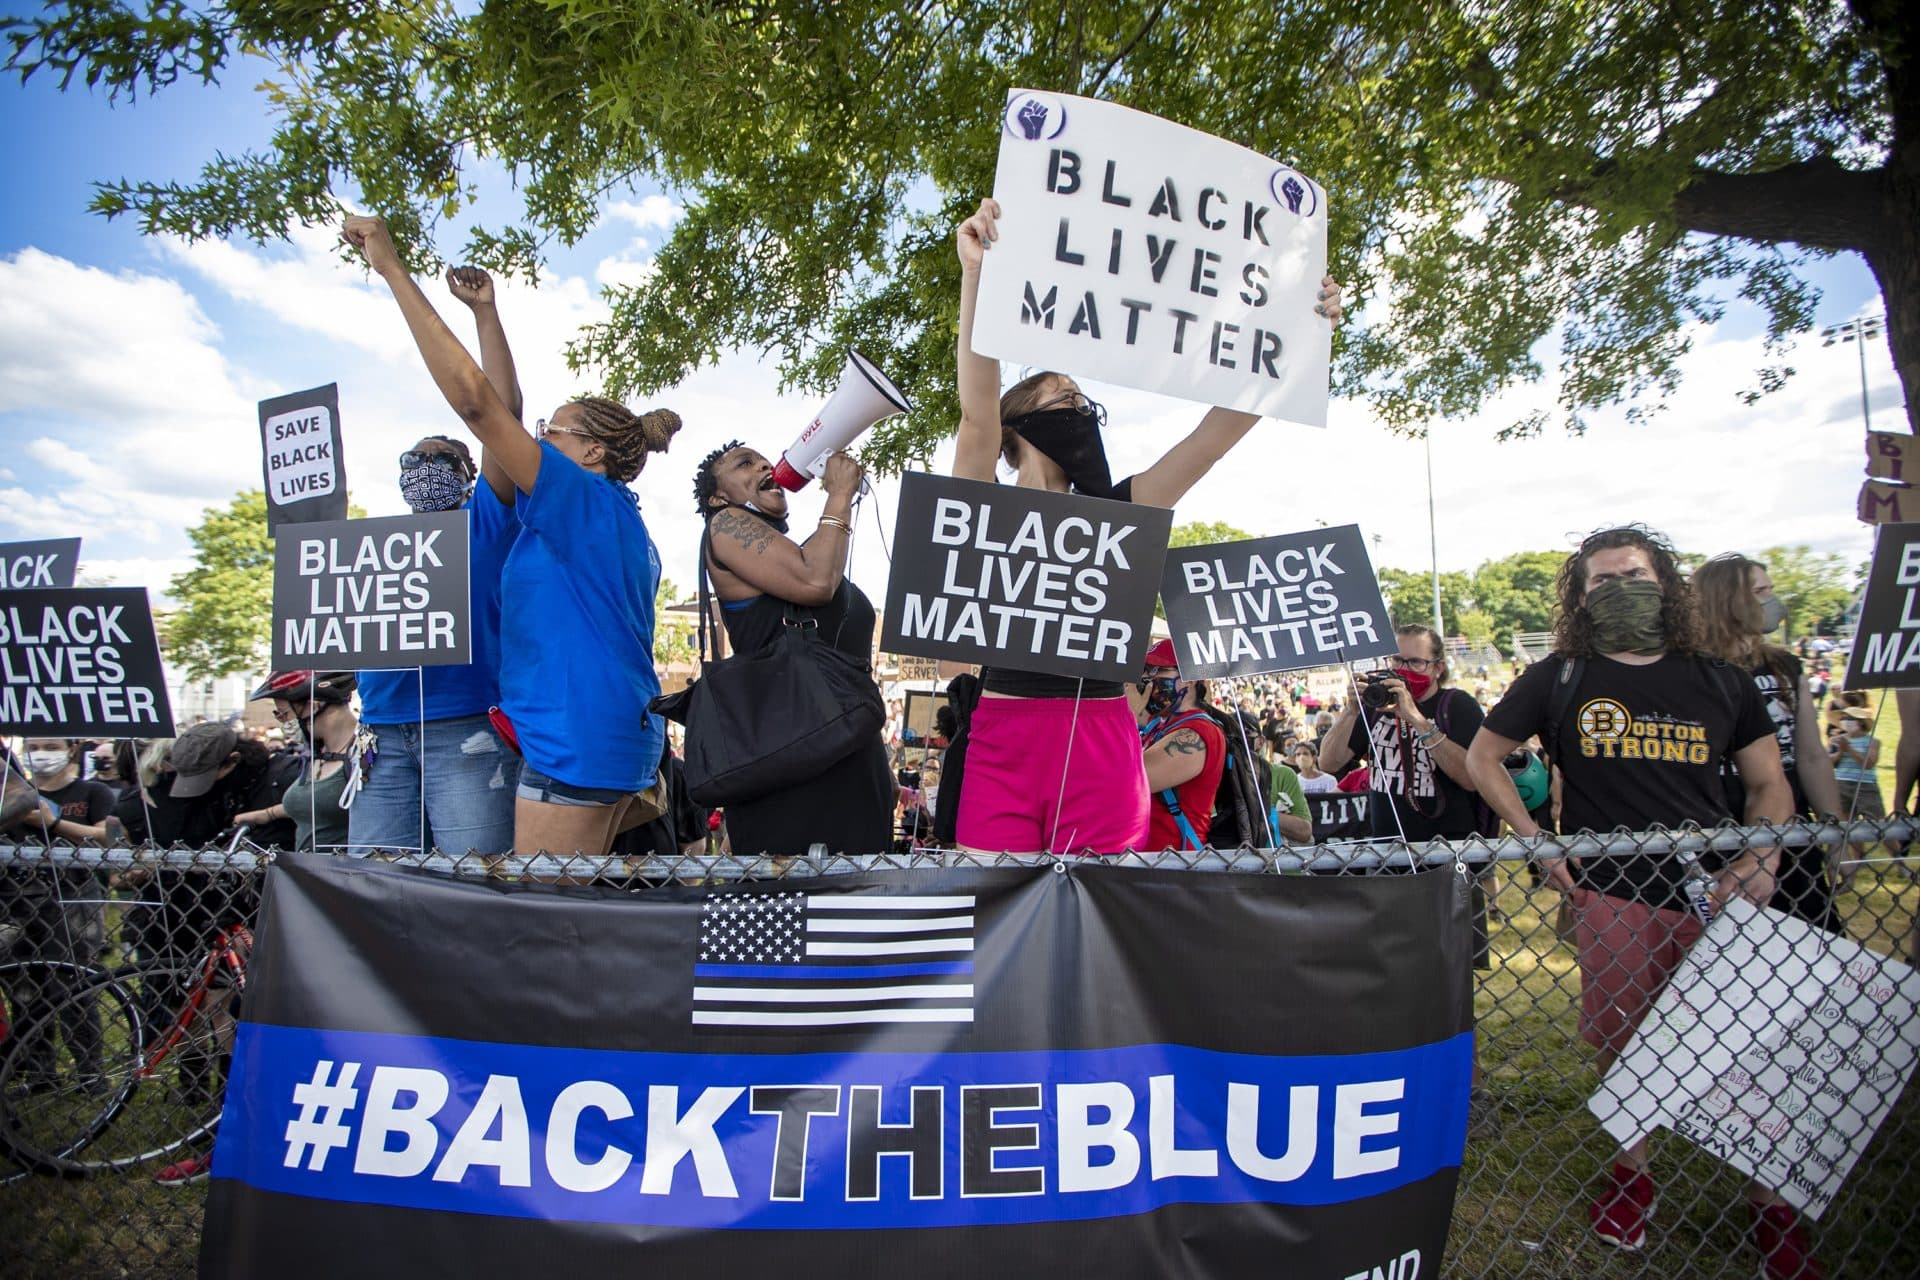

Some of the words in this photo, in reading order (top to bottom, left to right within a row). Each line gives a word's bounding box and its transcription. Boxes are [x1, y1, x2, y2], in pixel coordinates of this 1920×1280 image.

[1046, 149, 1270, 246] BLACK
[1055, 217, 1270, 307] LIVES
[1021, 280, 1283, 379] MATTER
[275, 416, 320, 441] SAVE
[801, 418, 823, 443] PYLE
[271, 442, 331, 470] BLACK
[281, 472, 330, 498] LIVES
[300, 529, 444, 576] BLACK
[932, 498, 1137, 570] BLACK
[943, 550, 1109, 614] LIVES
[1182, 543, 1345, 594] BLACK
[311, 571, 430, 615] LIVES
[1205, 580, 1339, 627] LIVES
[284, 611, 456, 656] MATTER
[901, 593, 1133, 664] MATTER
[1186, 610, 1380, 665] MATTER
[0, 646, 125, 684] LIVES
[901, 666, 936, 680] SERVE?
[1580, 737, 1710, 764] STRONG
[283, 1060, 1405, 1202] #BACKTHEBLUE
